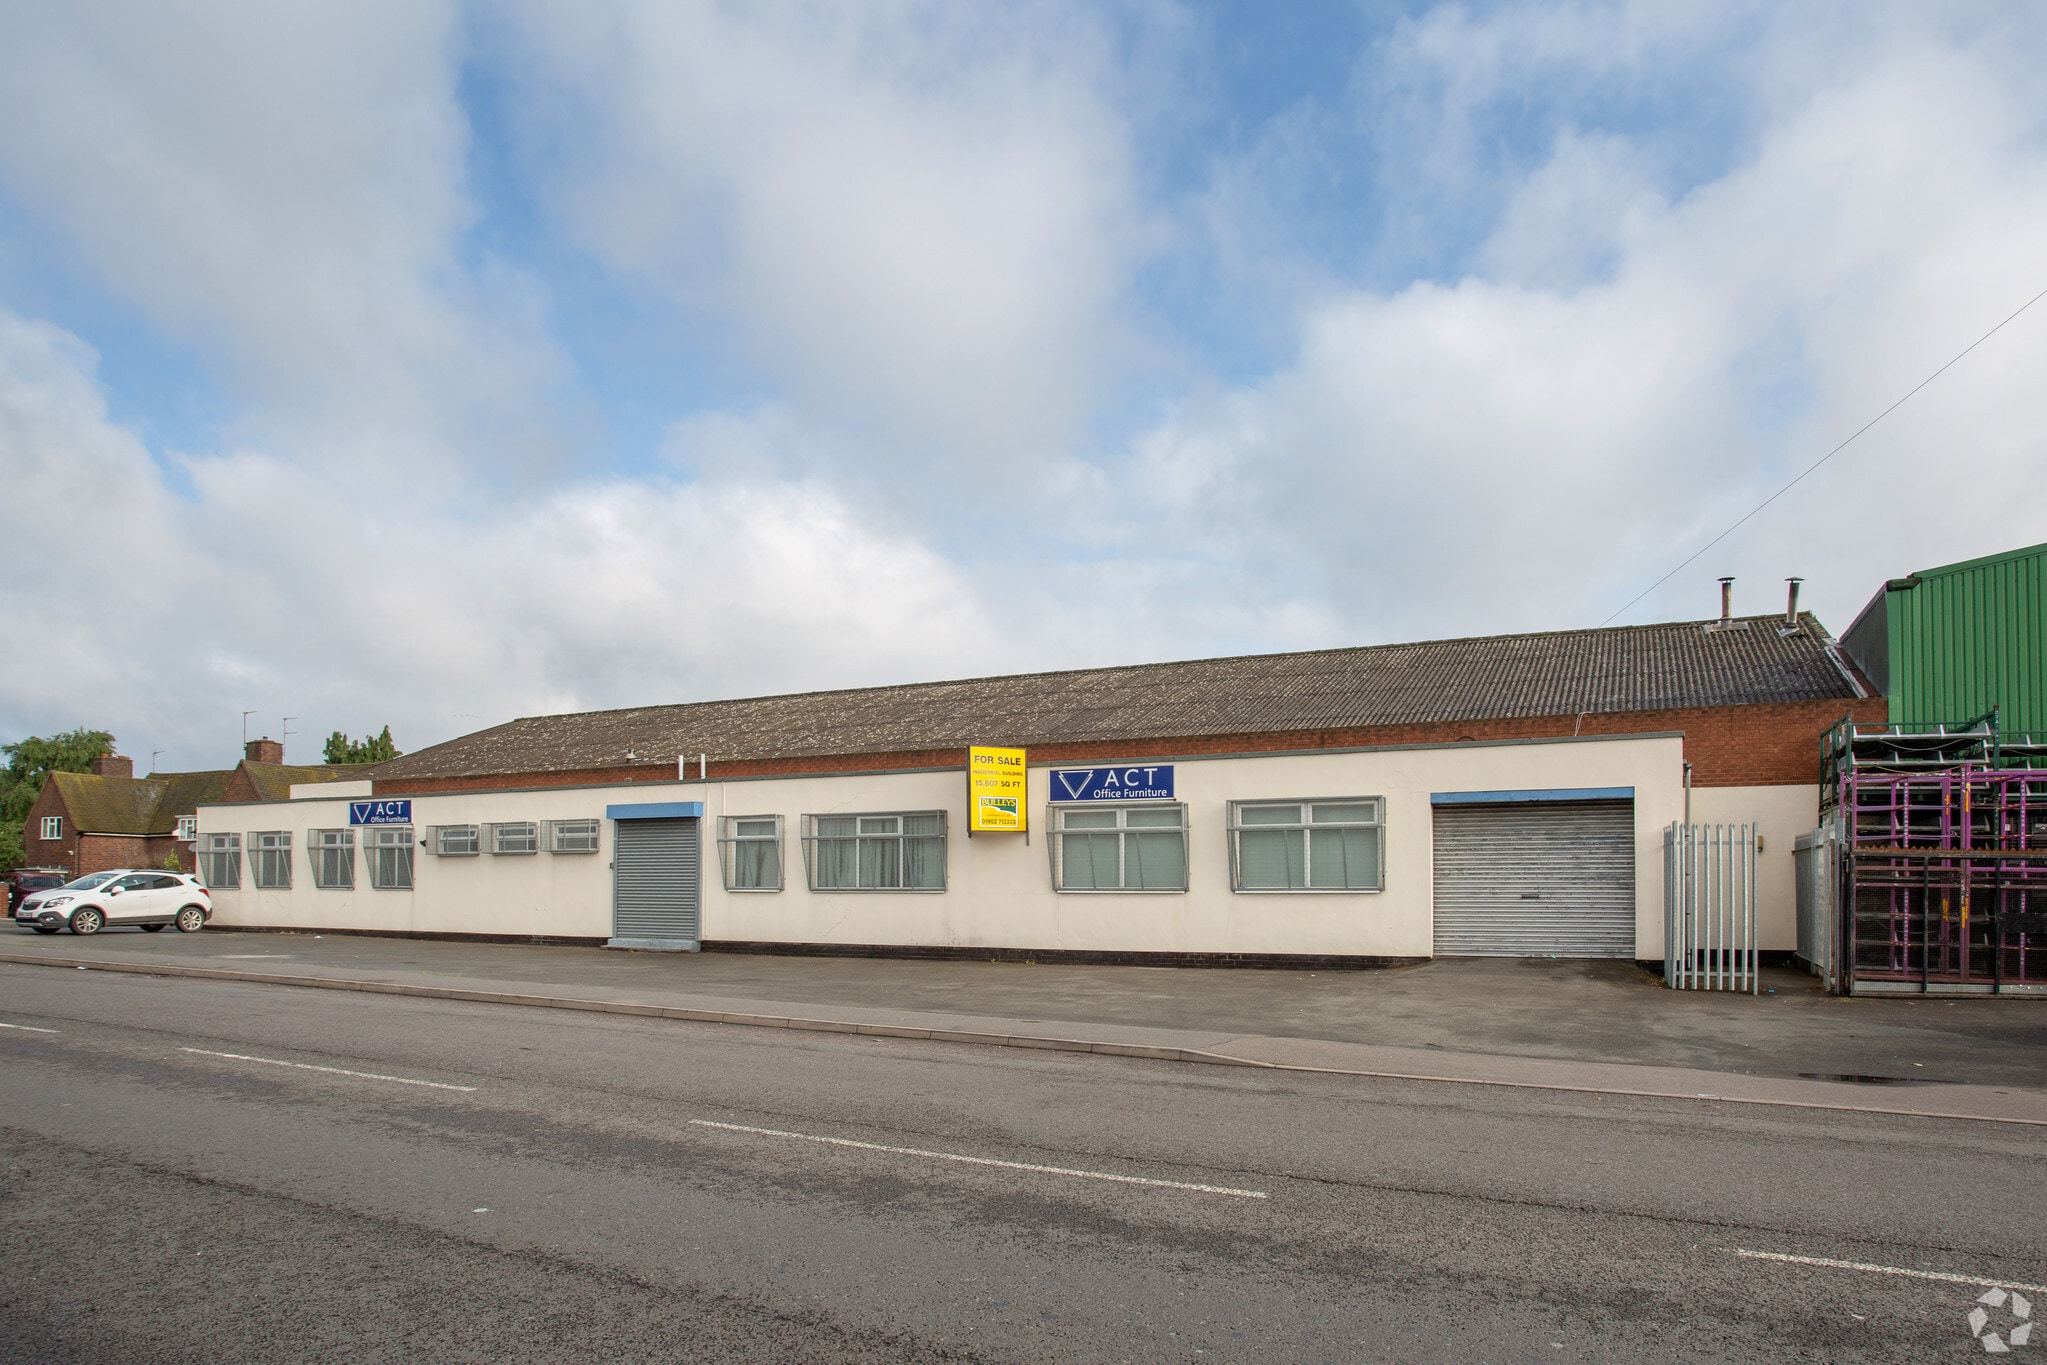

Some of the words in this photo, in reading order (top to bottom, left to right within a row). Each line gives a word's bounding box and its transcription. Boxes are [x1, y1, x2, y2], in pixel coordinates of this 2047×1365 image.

[974, 755, 994, 764] FOR
[997, 756, 1021, 766] SALE
[1104, 768, 1157, 787] ACT
[1093, 788, 1121, 798] Office
[1124, 787, 1168, 798] Furniture
[376, 802, 404, 815] ACT
[981, 799, 1016, 807] BULLEYS
